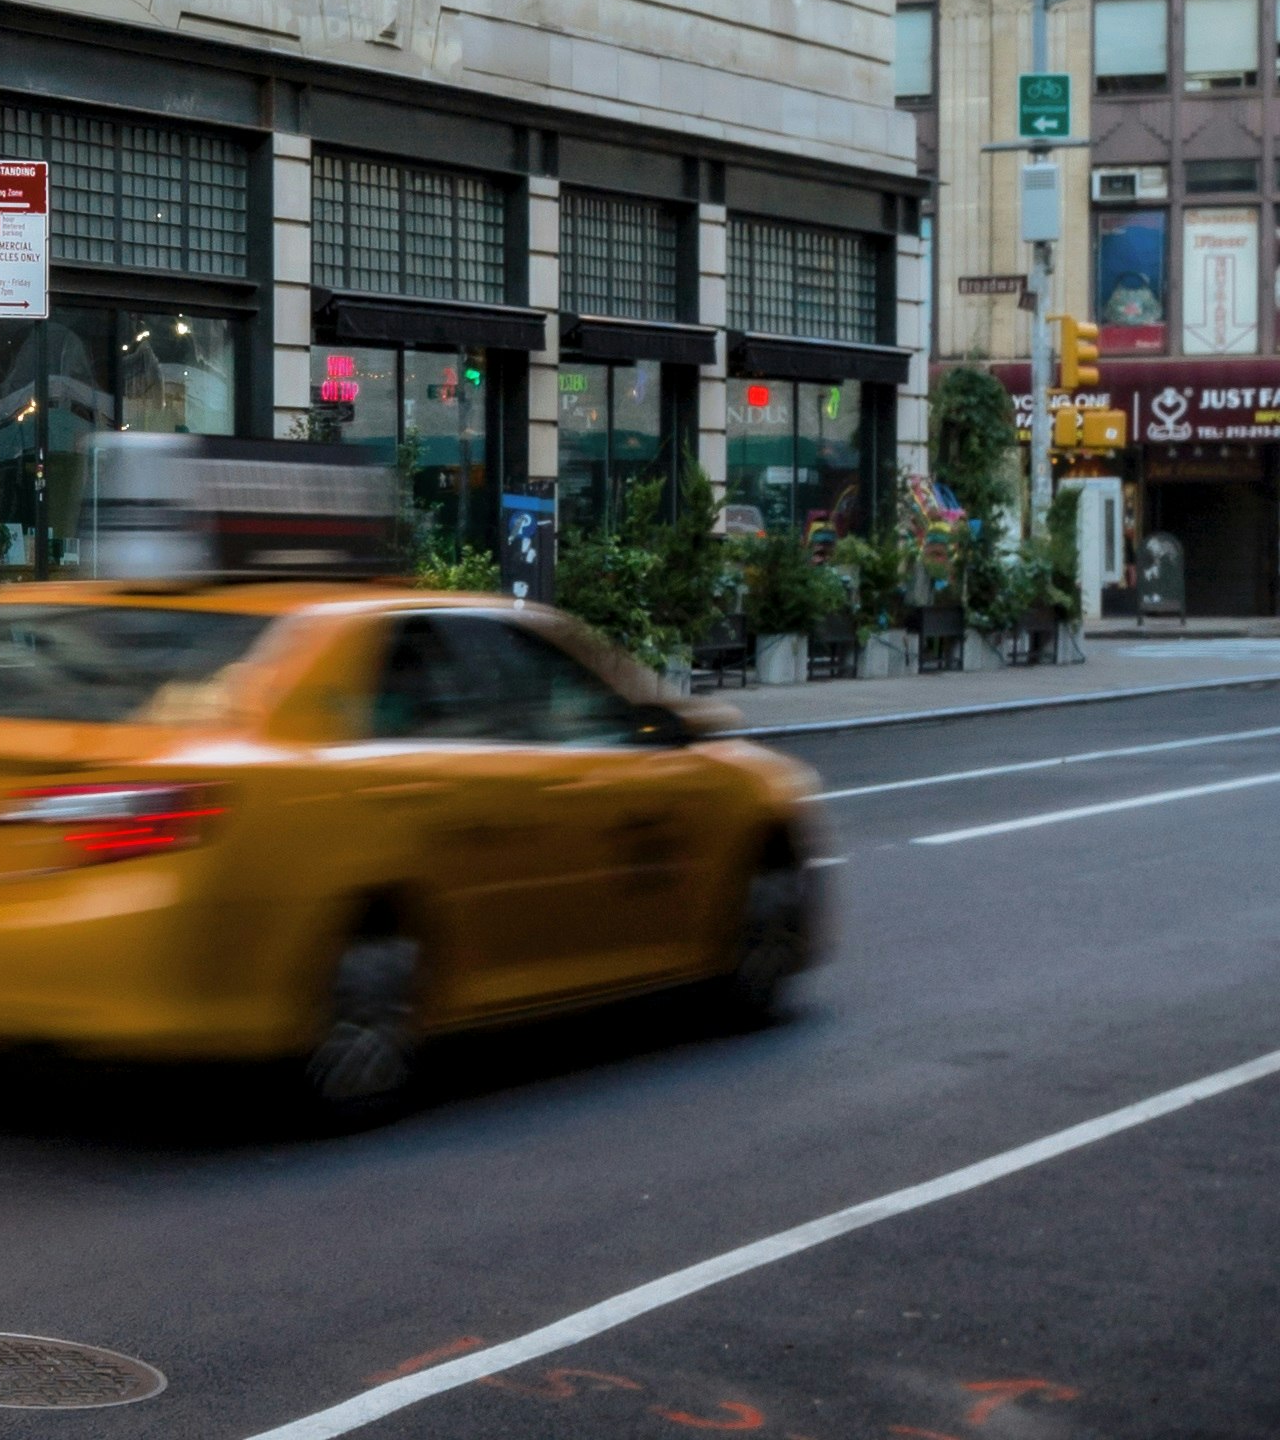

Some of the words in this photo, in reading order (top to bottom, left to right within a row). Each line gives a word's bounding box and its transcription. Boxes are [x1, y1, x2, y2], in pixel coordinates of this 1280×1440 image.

[7, 188, 23, 197] Zone
[20, 253, 40, 262] ONLY
[11, 278, 31, 288] Friday
[960, 278, 1021, 293] Broadway
[1199, 388, 1256, 409] JUST
